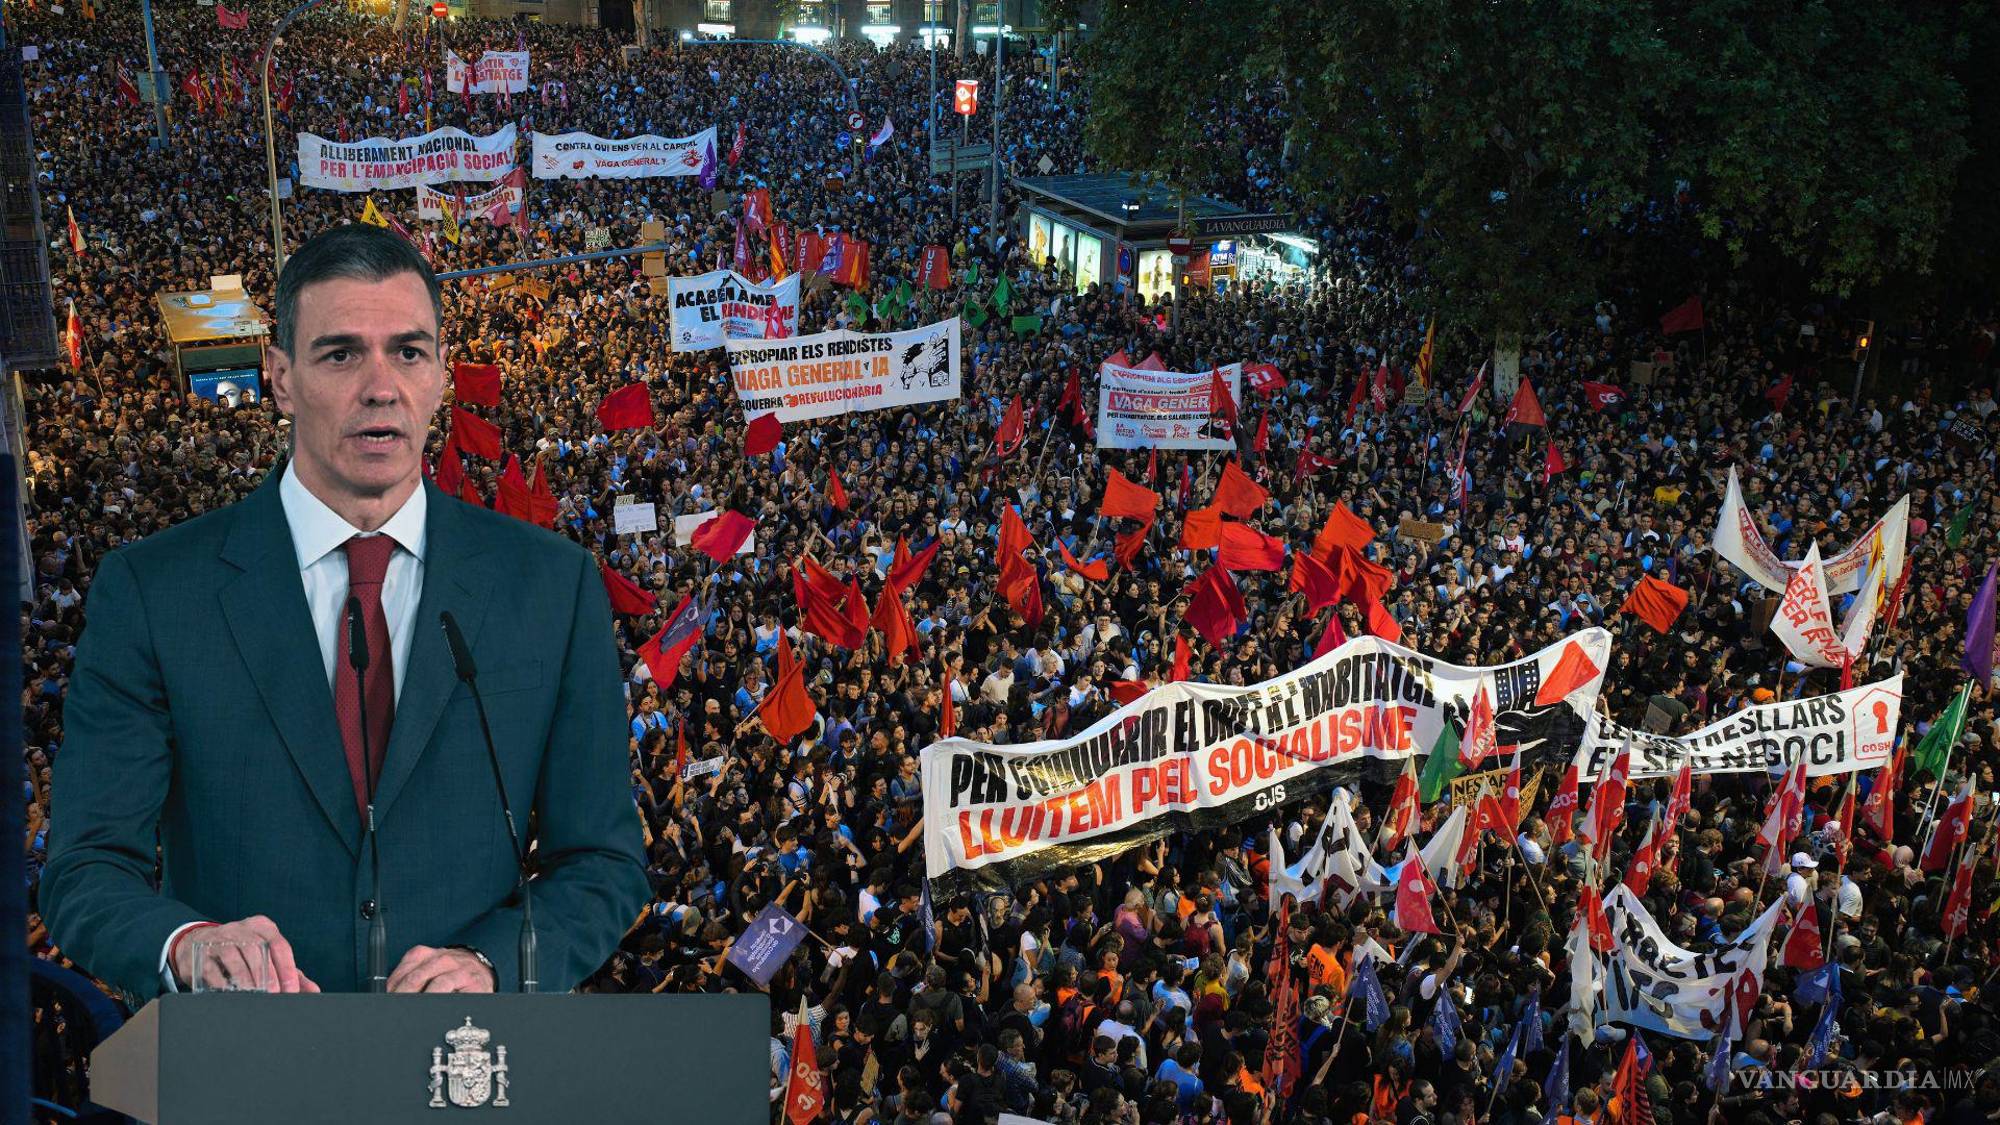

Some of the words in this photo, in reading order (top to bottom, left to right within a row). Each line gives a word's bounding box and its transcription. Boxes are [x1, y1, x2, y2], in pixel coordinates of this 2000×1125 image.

[320, 144, 414, 163] ALLIBERAMENT
[417, 137, 478, 157] NACIONAL
[555, 142, 593, 151] CONTRA
[612, 143, 630, 152] ENS
[320, 160, 347, 178] PER
[595, 159, 621, 168] VAGA
[621, 158, 660, 168] GENERAL
[1206, 222, 1220, 233] LA
[1219, 219, 1286, 232] VANGUARDIA
[1211, 253, 1228, 261] ATM
[700, 306, 721, 323] EL
[728, 347, 798, 366] EXPROPIAR
[801, 343, 824, 360] ELS
[827, 337, 893, 357] RENDISTES
[734, 366, 782, 391] VAGA
[787, 359, 864, 387] GENERAL
[1114, 395, 1153, 410] VAGA
[1157, 394, 1210, 410] GENER
[950, 751, 1008, 808] PER
[1173, 697, 1200, 751] EL
[1203, 690, 1261, 747] DRET
[1720, 729, 1846, 771] NEGOCI
[959, 773, 1122, 860] LLUITEM
[1131, 756, 1198, 814] PEL
[1207, 704, 1418, 797] SOCIALISME
